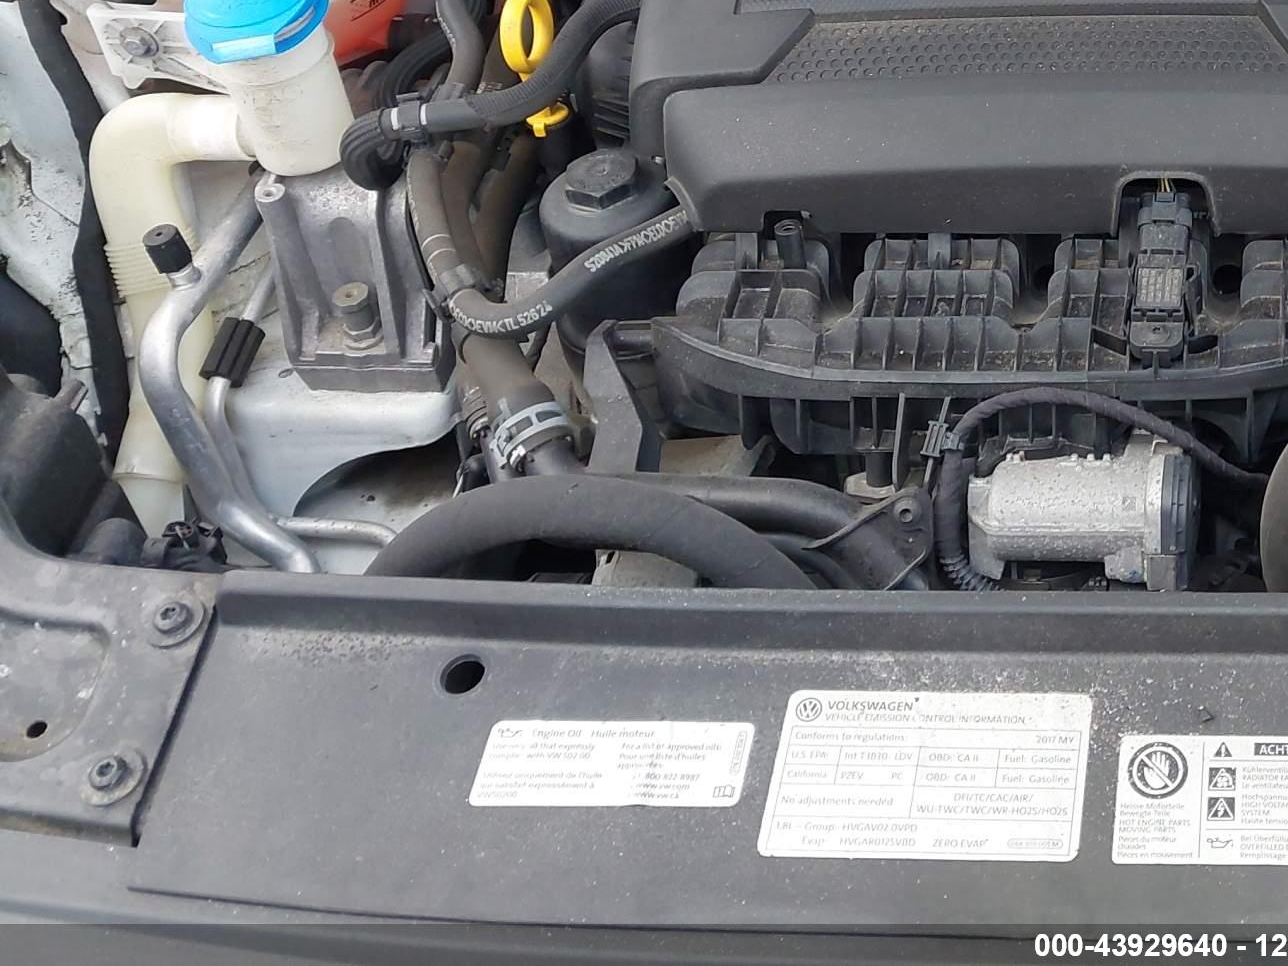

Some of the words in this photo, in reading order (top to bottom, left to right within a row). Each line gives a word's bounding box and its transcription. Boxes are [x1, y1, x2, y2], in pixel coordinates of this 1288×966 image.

[827, 700, 915, 712] VOLKSWAGEN
[825, 713, 861, 722] VEHICLE
[864, 714, 910, 722] EMISSION
[912, 714, 955, 723] CONTROL
[958, 714, 1026, 724] INFORMATION
[532, 729, 566, 740] Engine
[591, 729, 616, 738] Huile
[619, 729, 655, 738] moteur
[795, 731, 840, 740] Conforms
[842, 731, 852, 740] to
[666, 743, 704, 751] approved
[894, 752, 913, 761] LDV
[957, 753, 971, 762] CA
[1004, 754, 1025, 763] Fuel:
[1031, 754, 1072, 764] Gasoline
[787, 770, 828, 778] California
[954, 773, 968, 782] CA
[1002, 774, 1024, 783] Fuel:
[1029, 774, 1070, 784] Gasoline
[1242, 782, 1250, 790] Le
[781, 796, 795, 804] No
[798, 796, 855, 807] adjustments
[858, 797, 894, 806] needed
[1241, 802, 1261, 810] HIGH
[932, 838, 958, 848] ZERO
[960, 838, 986, 848] EVAP
